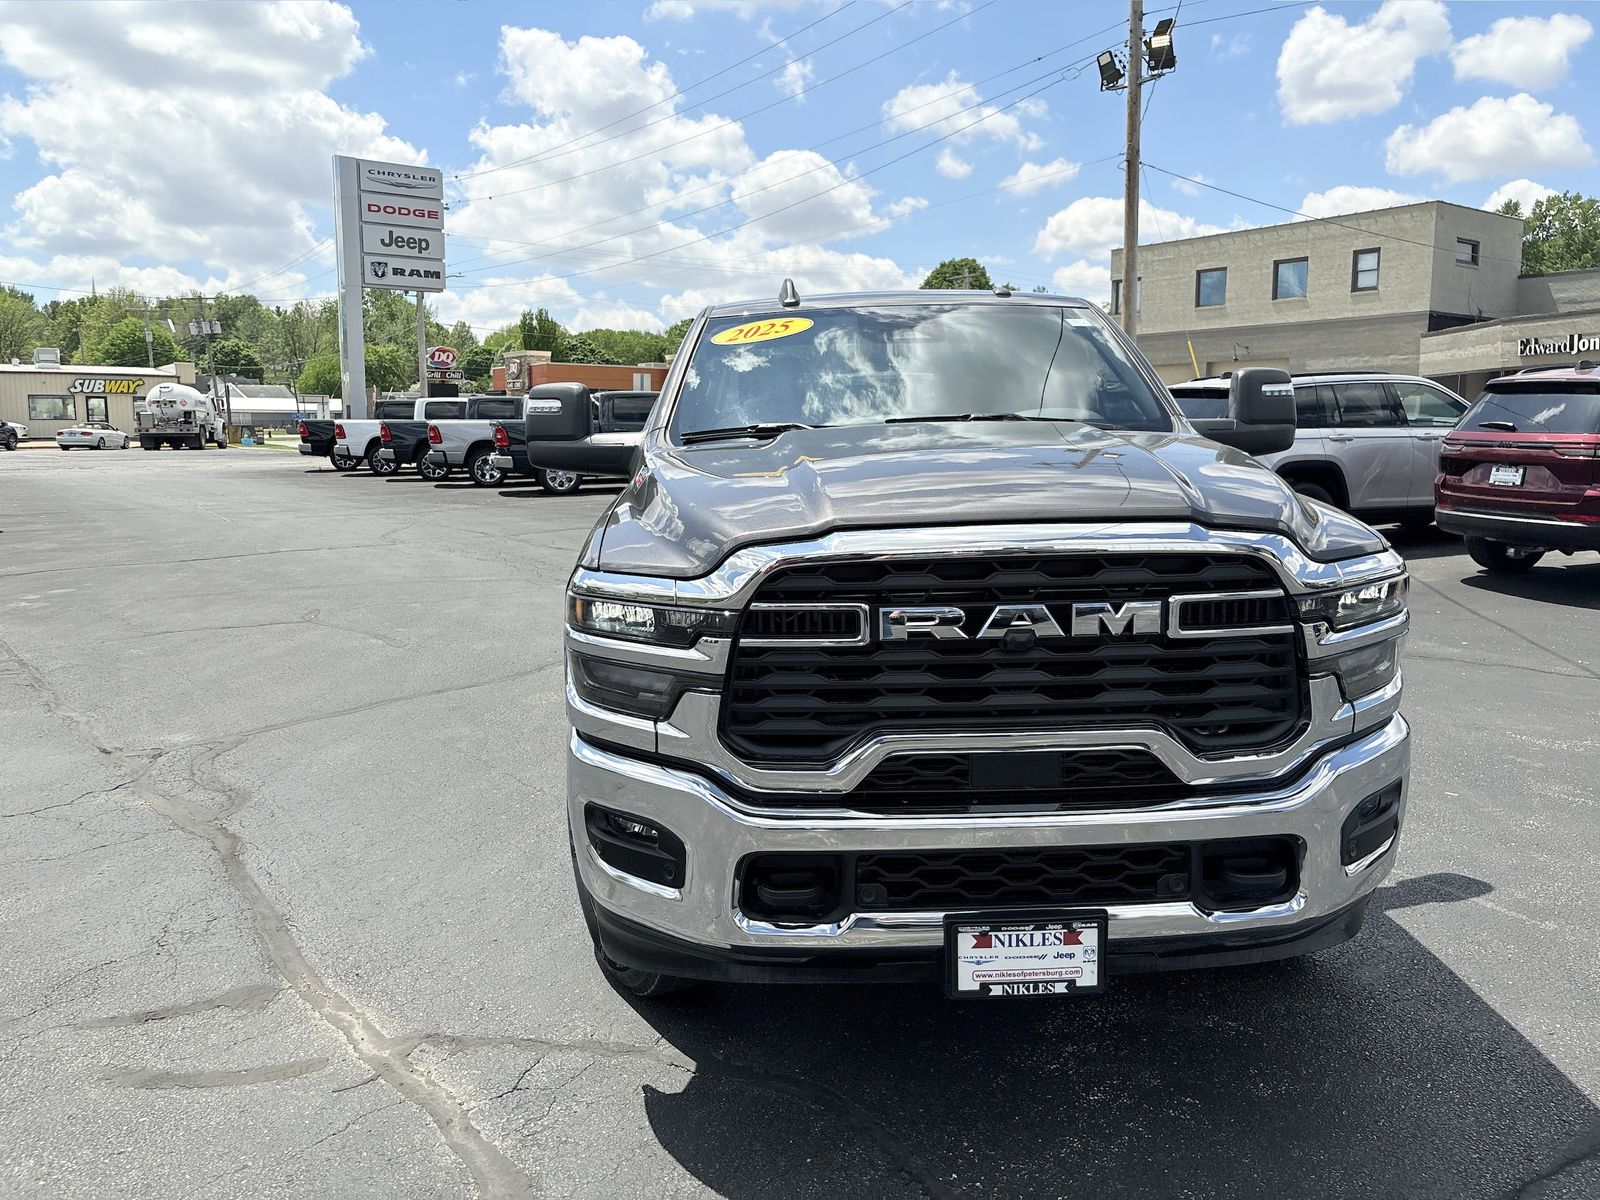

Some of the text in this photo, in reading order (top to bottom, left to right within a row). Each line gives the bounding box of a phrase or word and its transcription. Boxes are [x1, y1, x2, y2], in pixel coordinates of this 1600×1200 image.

[368, 169, 436, 182] CHRYSLER
[368, 204, 439, 219] DODGE
[380, 230, 430, 254] Jeep
[392, 267, 441, 280] RAM
[726, 320, 794, 342] 2025
[1518, 334, 1570, 356] Edward
[433, 351, 454, 364] DQ
[69, 378, 144, 394] SUBWAY
[878, 600, 1162, 640] RAM
[993, 932, 1062, 948] NIKLES
[1054, 952, 1076, 960] Jeep
[975, 968, 1080, 980] www.niklesofpetersburg.com
[1002, 983, 1055, 996] NIKLES
